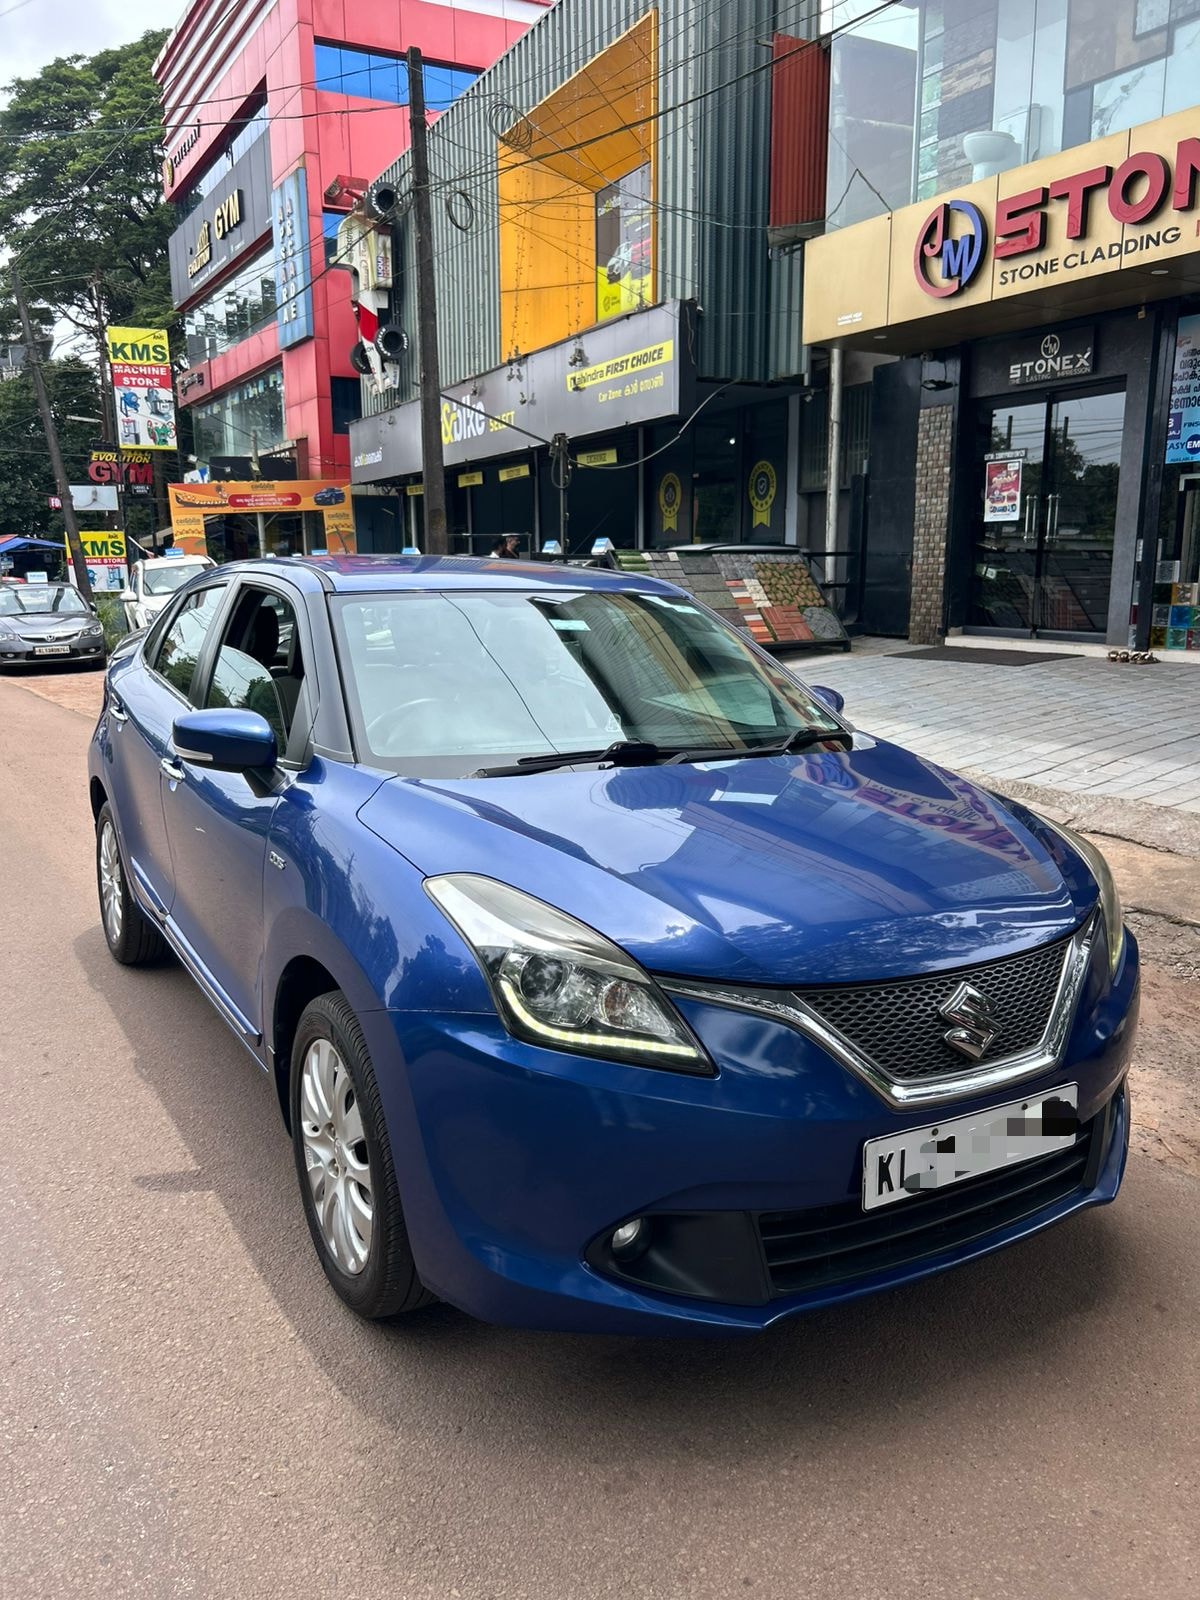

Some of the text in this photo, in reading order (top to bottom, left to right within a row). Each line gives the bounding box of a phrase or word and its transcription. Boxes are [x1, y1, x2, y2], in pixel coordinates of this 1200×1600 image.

[214, 189, 242, 240] GYM
[188, 247, 211, 279] EVOLUTION
[286, 198, 297, 320] ARCADE
[999, 226, 1182, 286] STONE CLADDING
[111, 342, 168, 364] KMS
[605, 358, 629, 377] FIRST
[630, 347, 663, 369] CHOICE
[1009, 348, 1091, 379] STONEX
[113, 365, 167, 376] MACHINE
[122, 376, 160, 387] STORE
[489, 410, 515, 433] SELECT
[1167, 441, 1186, 450] ASY
[88, 461, 154, 485] GYM
